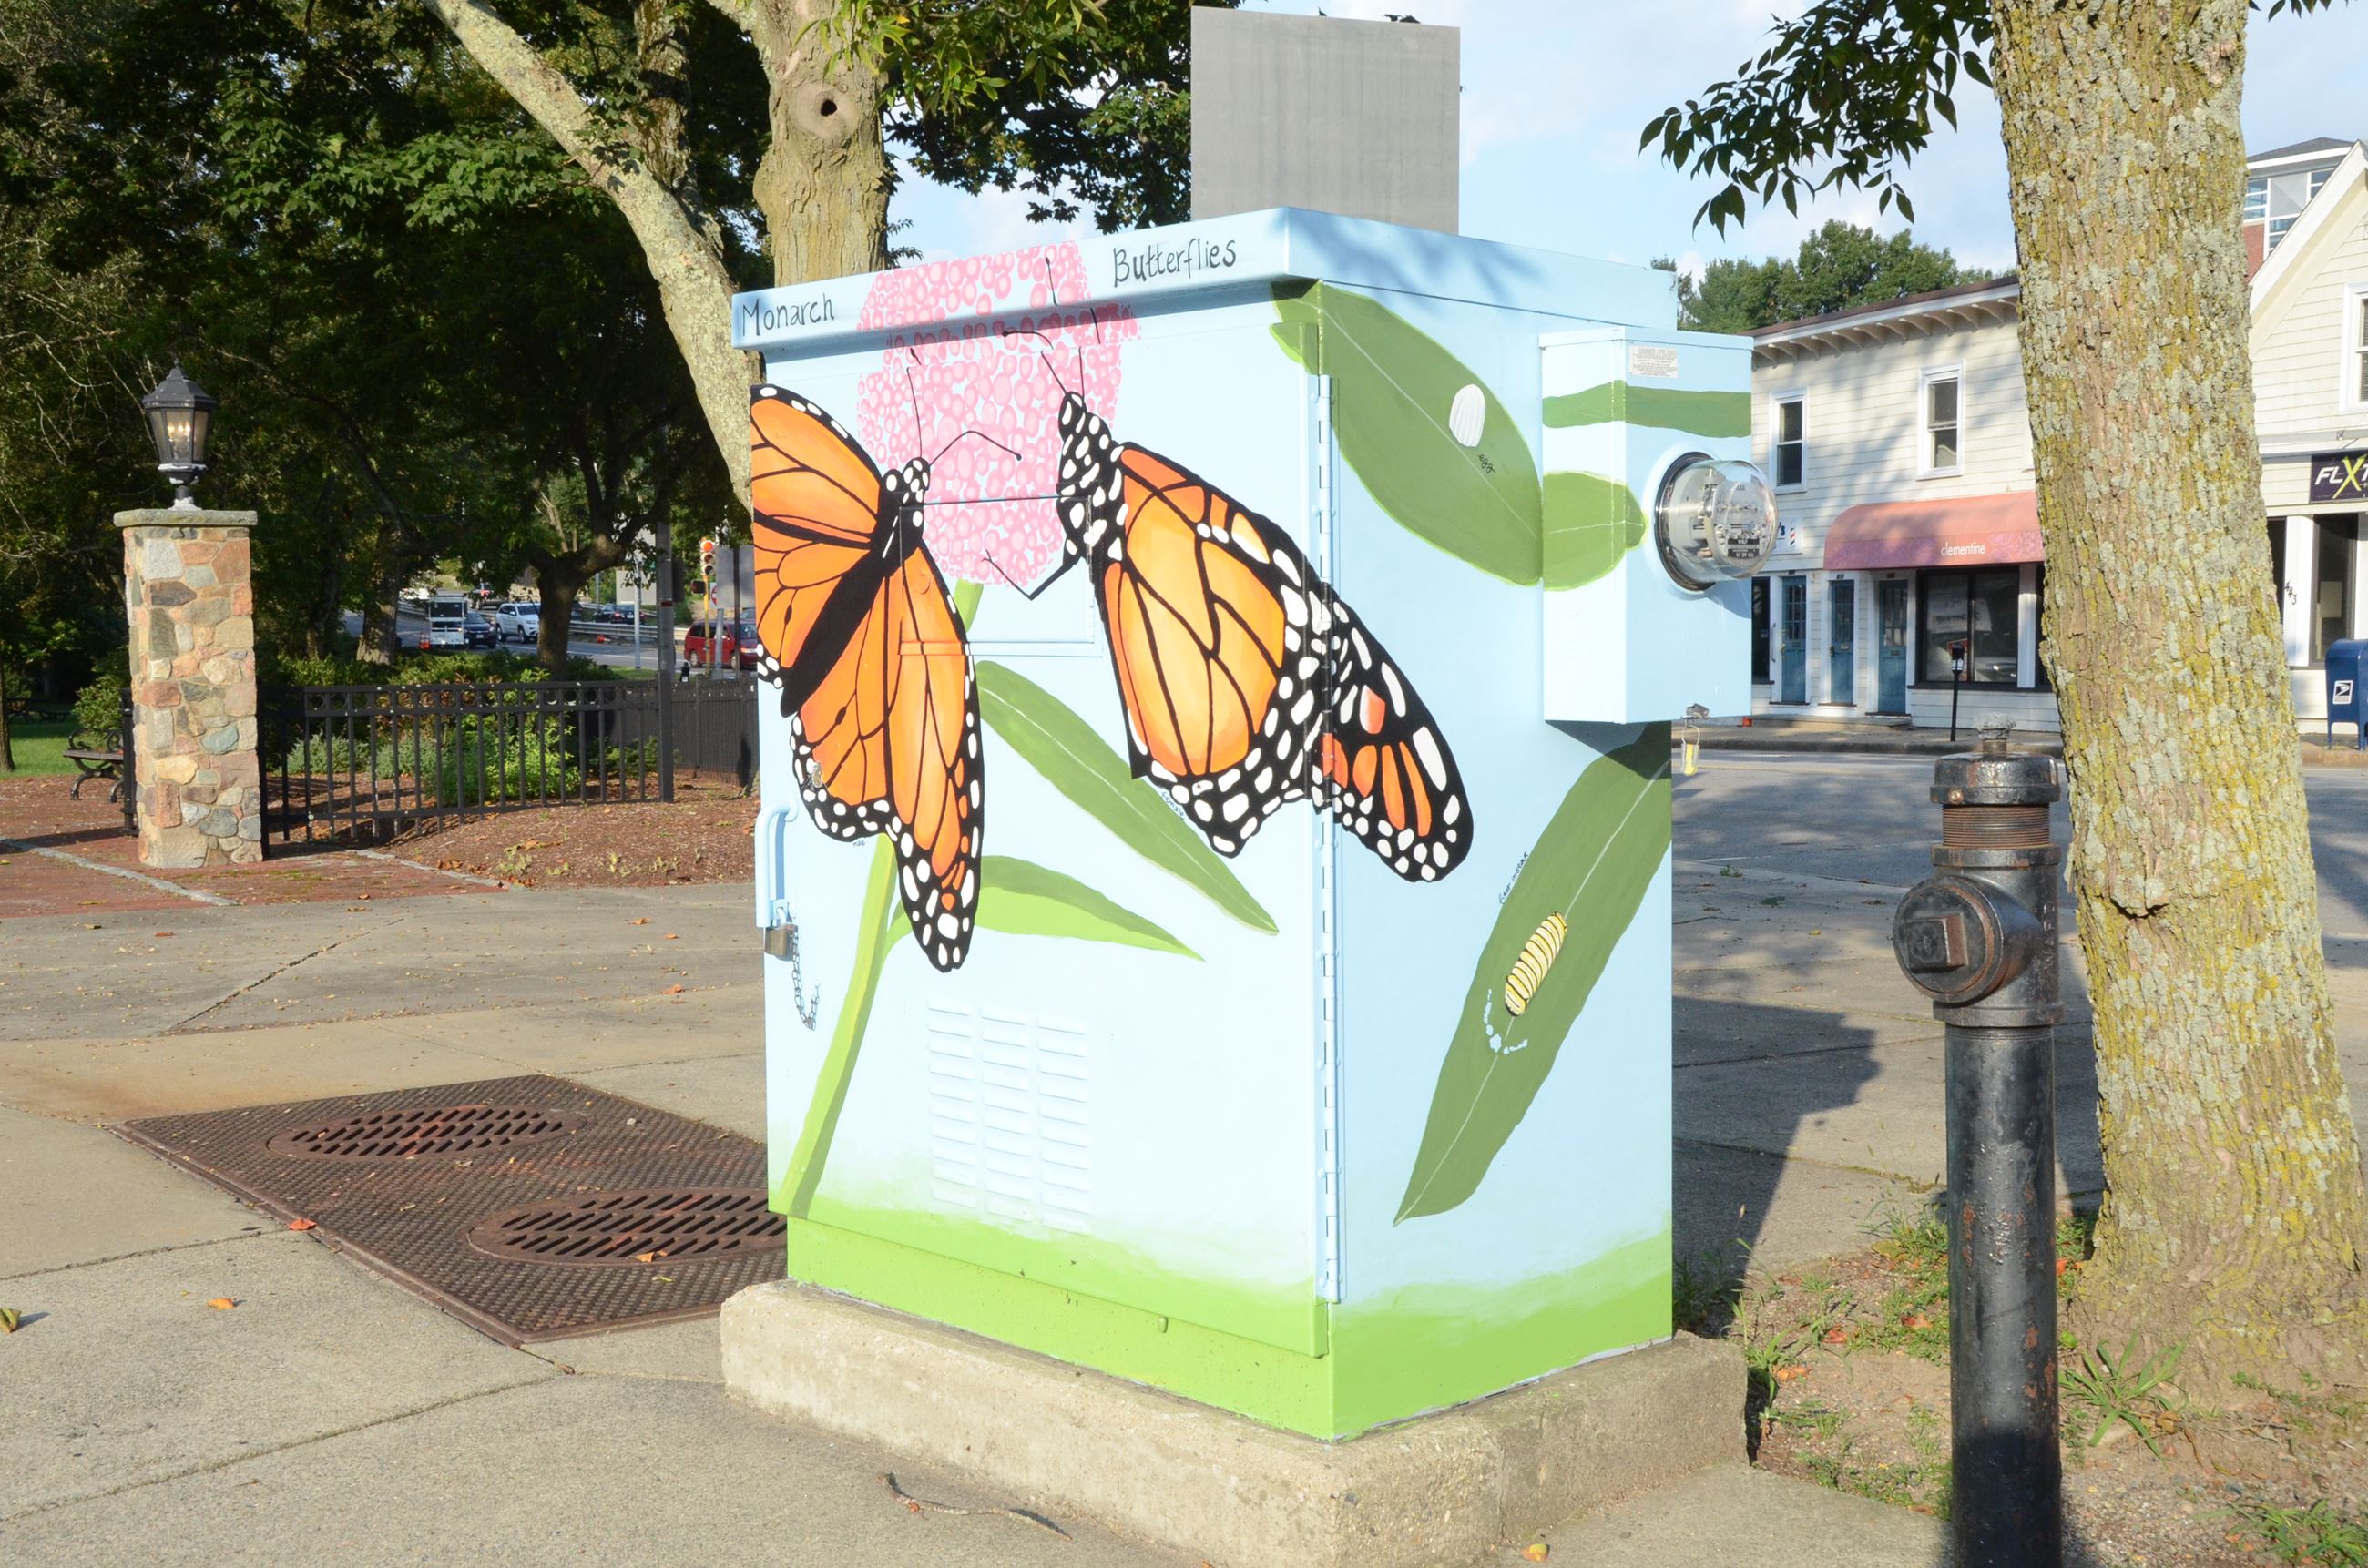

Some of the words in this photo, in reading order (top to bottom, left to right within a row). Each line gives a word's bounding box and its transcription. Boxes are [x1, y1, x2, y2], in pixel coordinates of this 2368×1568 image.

[742, 292, 835, 337] Monarch
[1113, 238, 1237, 288] Butterflies
[1477, 453, 1495, 473] egg
[1941, 541, 1986, 556] clementine
